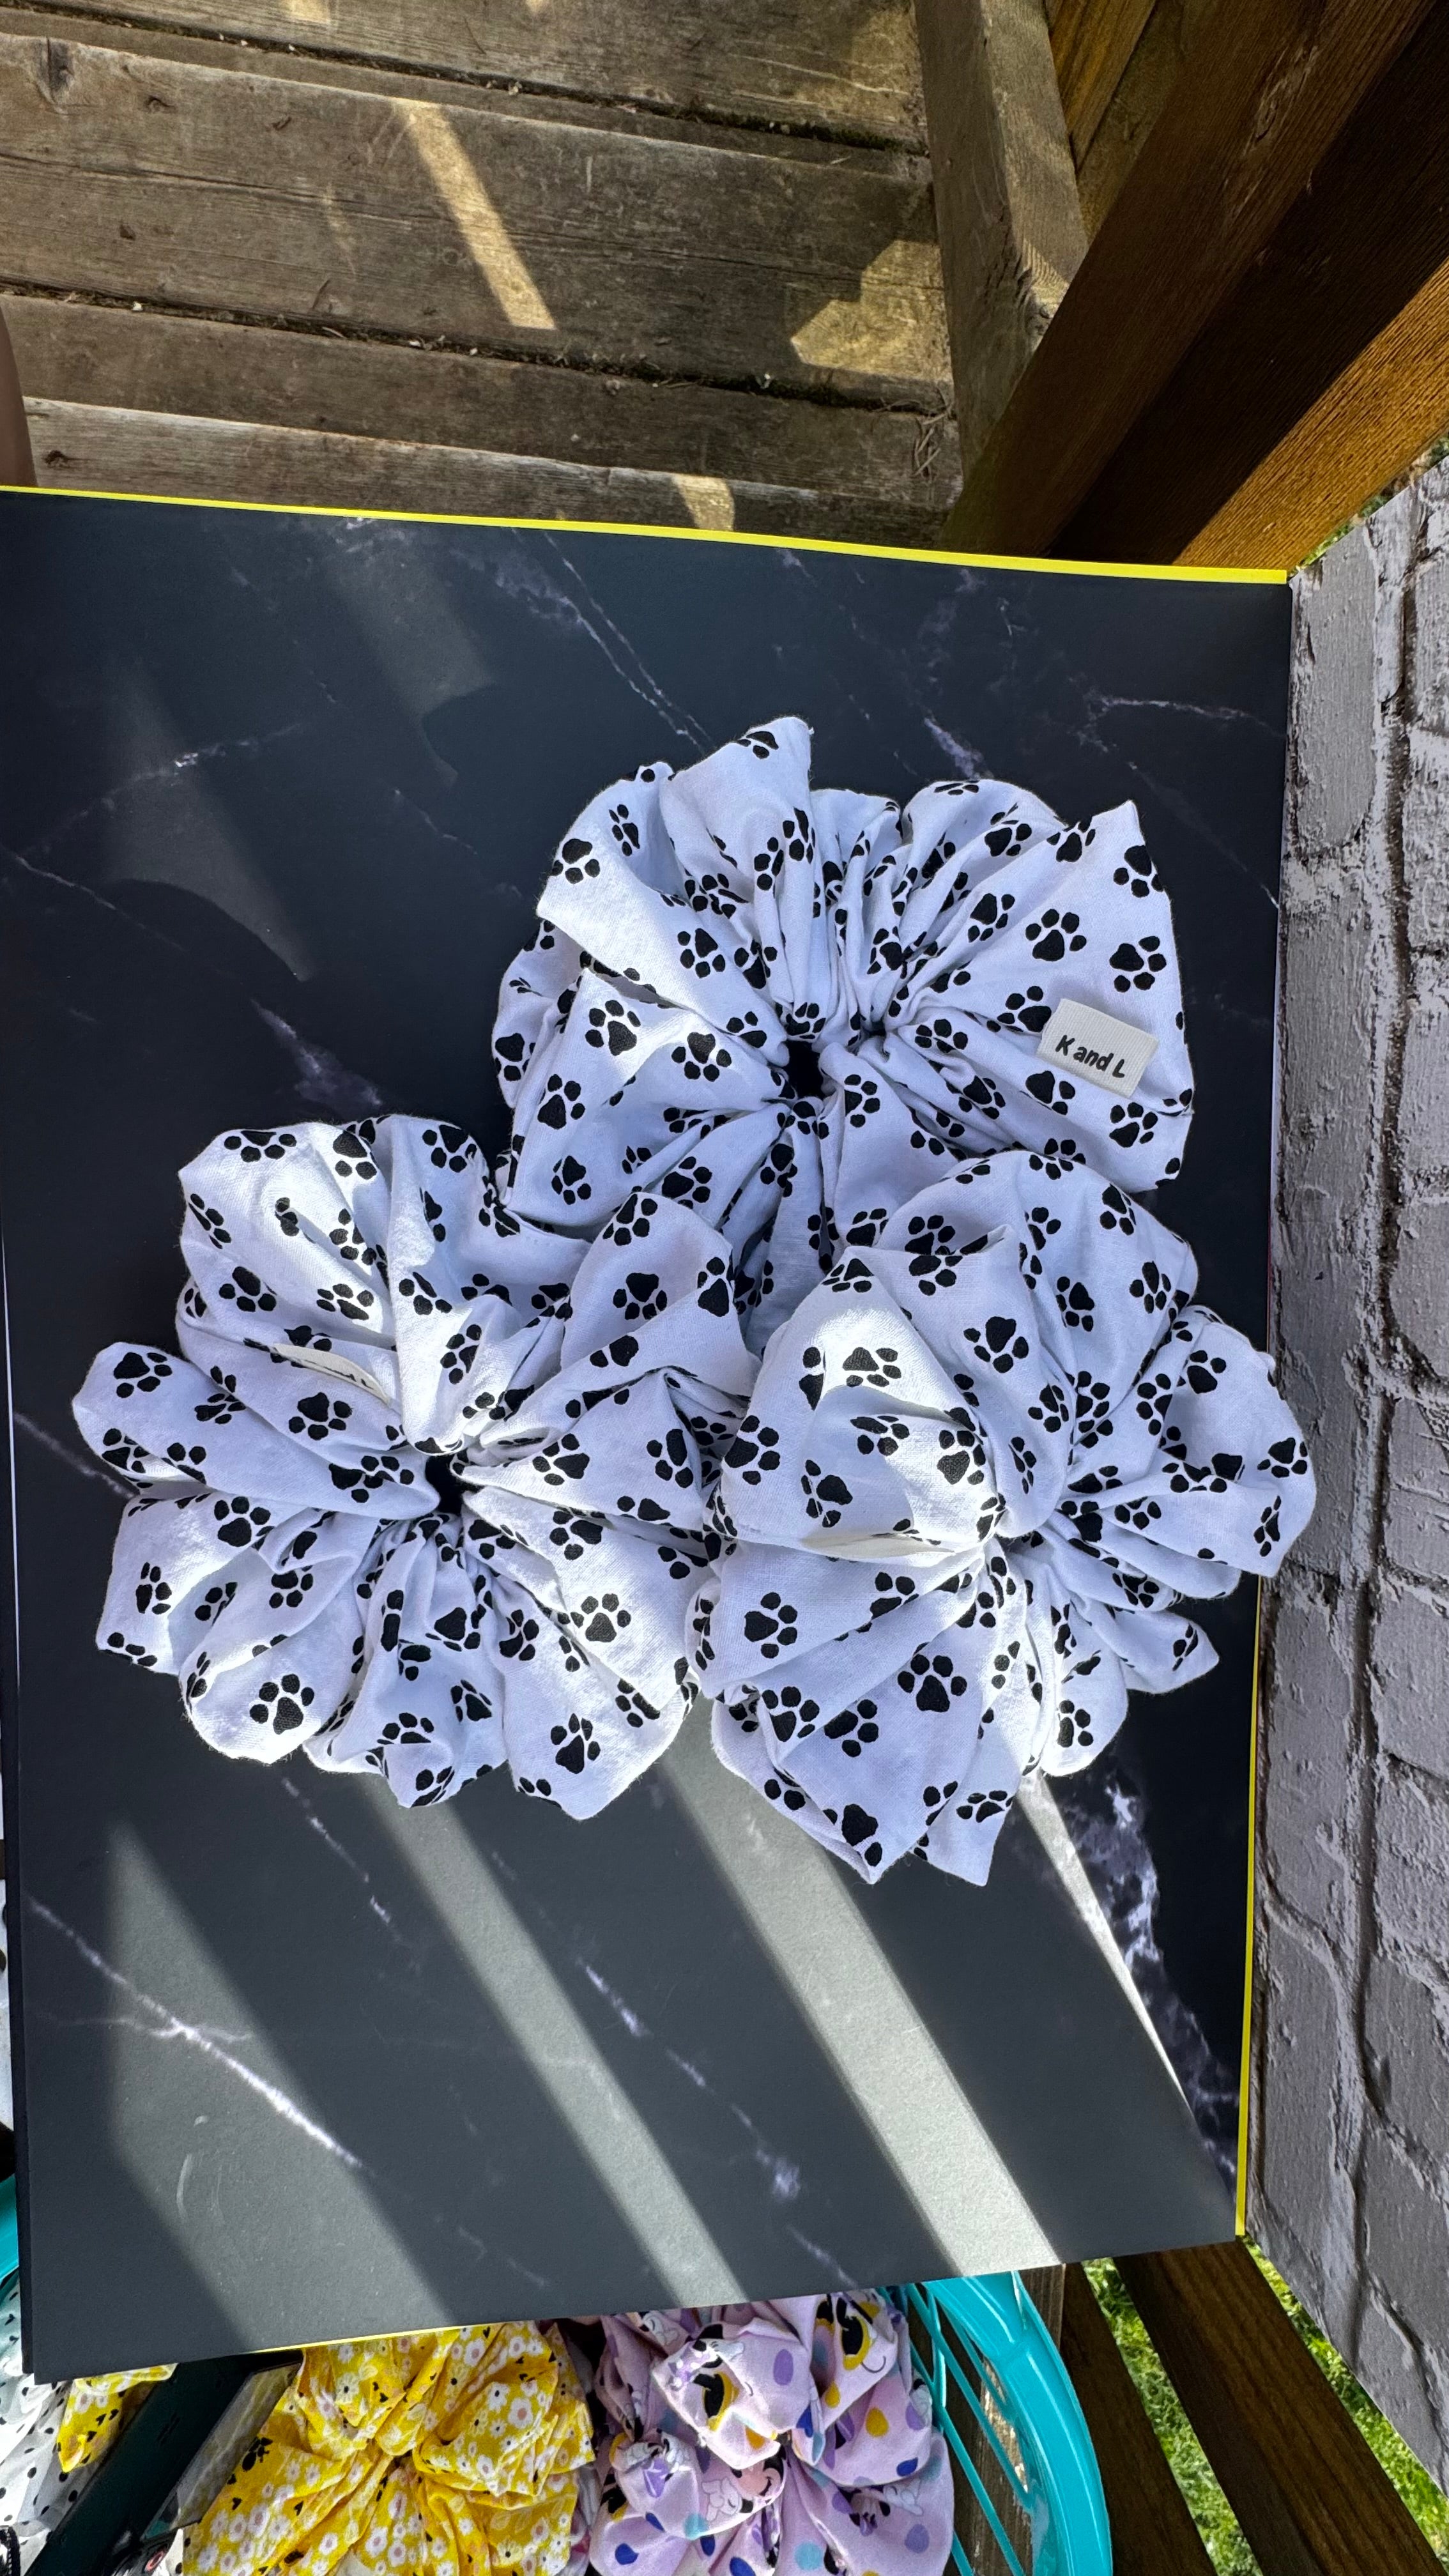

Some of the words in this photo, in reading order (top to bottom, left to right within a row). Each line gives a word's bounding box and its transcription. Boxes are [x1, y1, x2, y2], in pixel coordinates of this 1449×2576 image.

[1055, 1034, 1075, 1055] K
[1073, 1046, 1114, 1071] and
[1112, 1059, 1125, 1078] L
